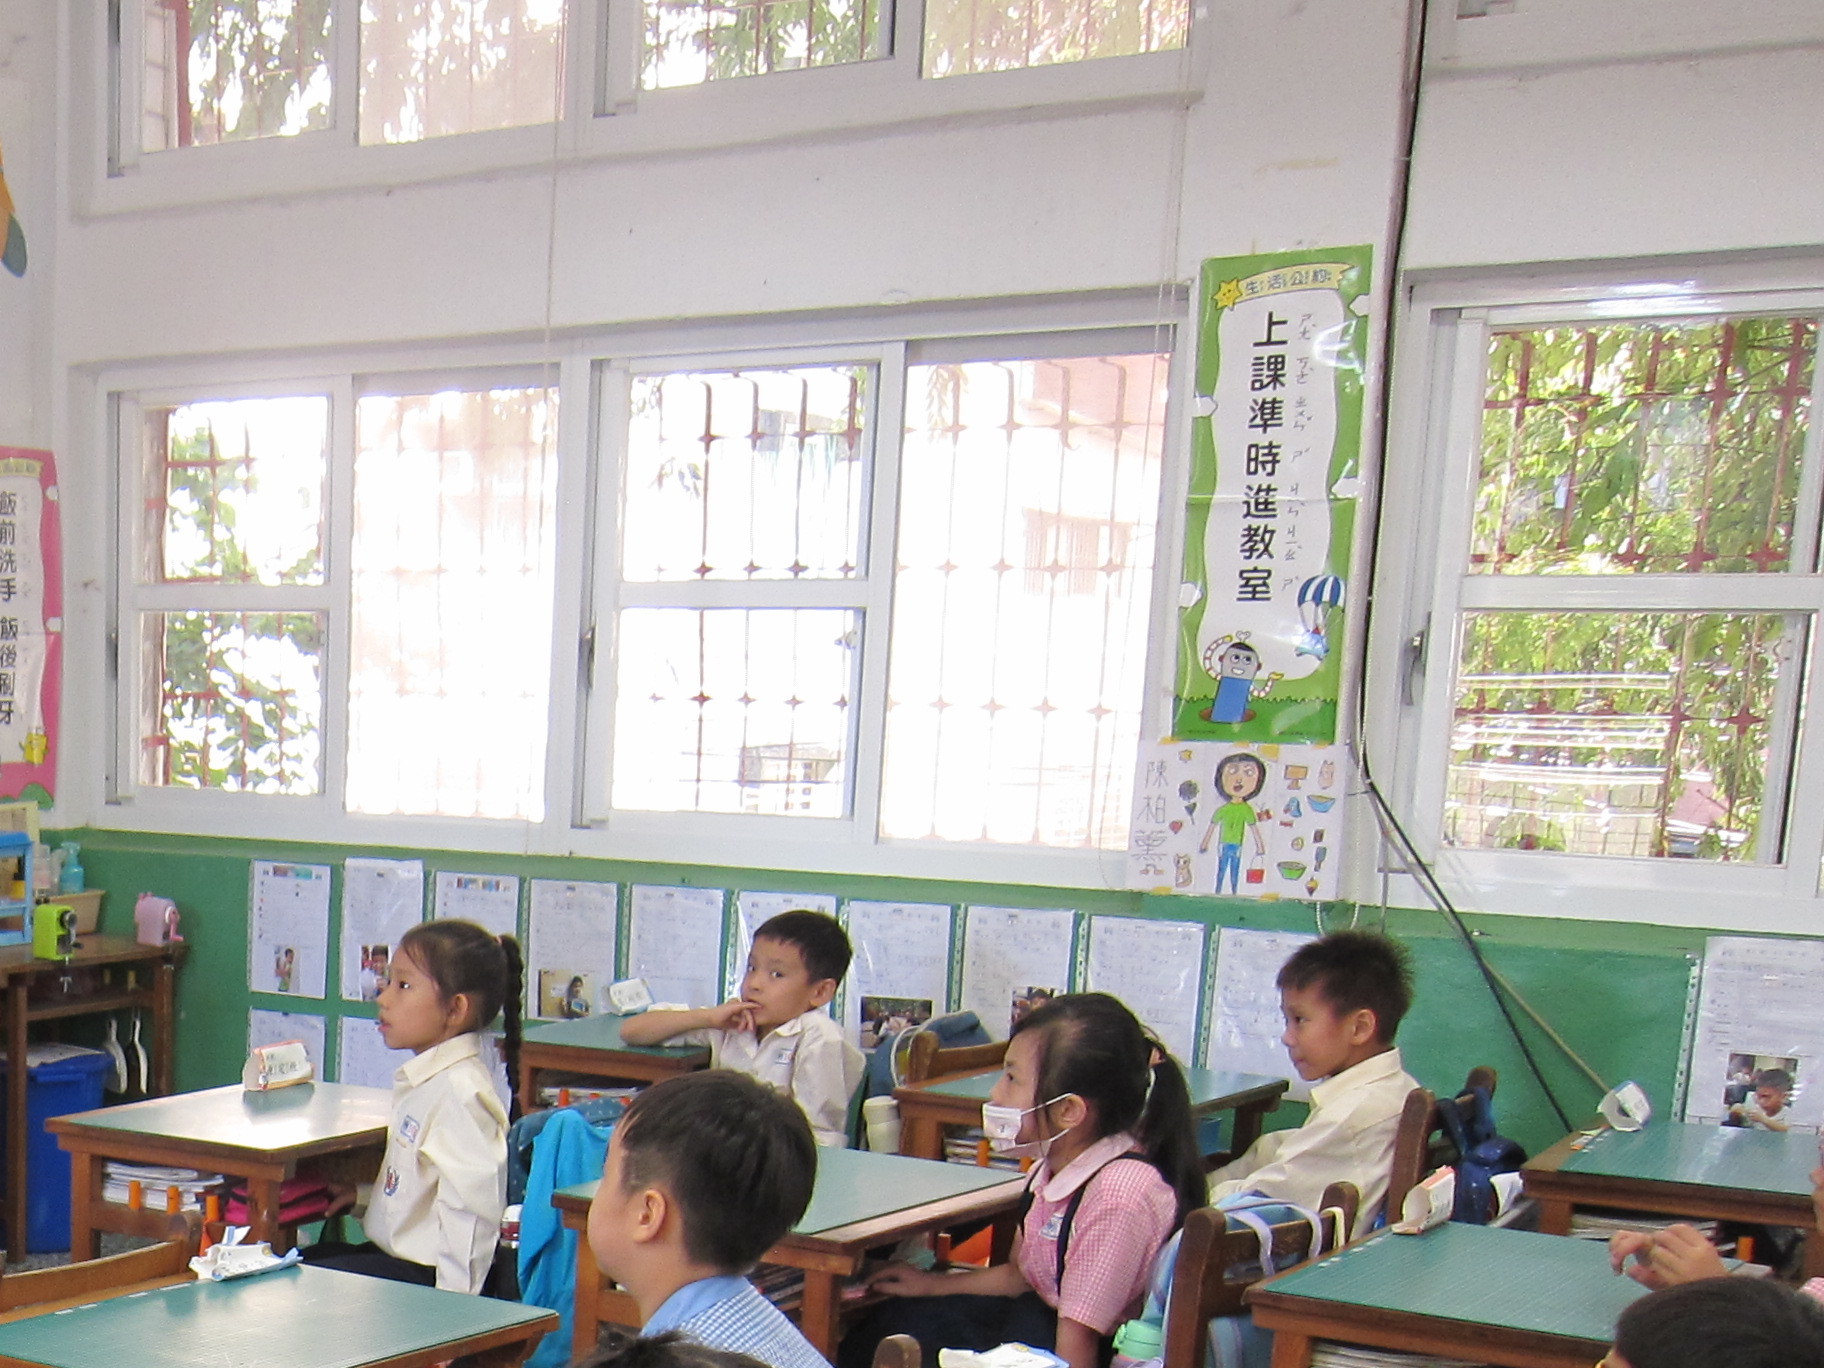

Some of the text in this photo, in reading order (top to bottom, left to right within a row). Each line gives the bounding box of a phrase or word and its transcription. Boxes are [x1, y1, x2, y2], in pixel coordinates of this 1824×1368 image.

[1236, 310, 1290, 604] 上課準時進教室
